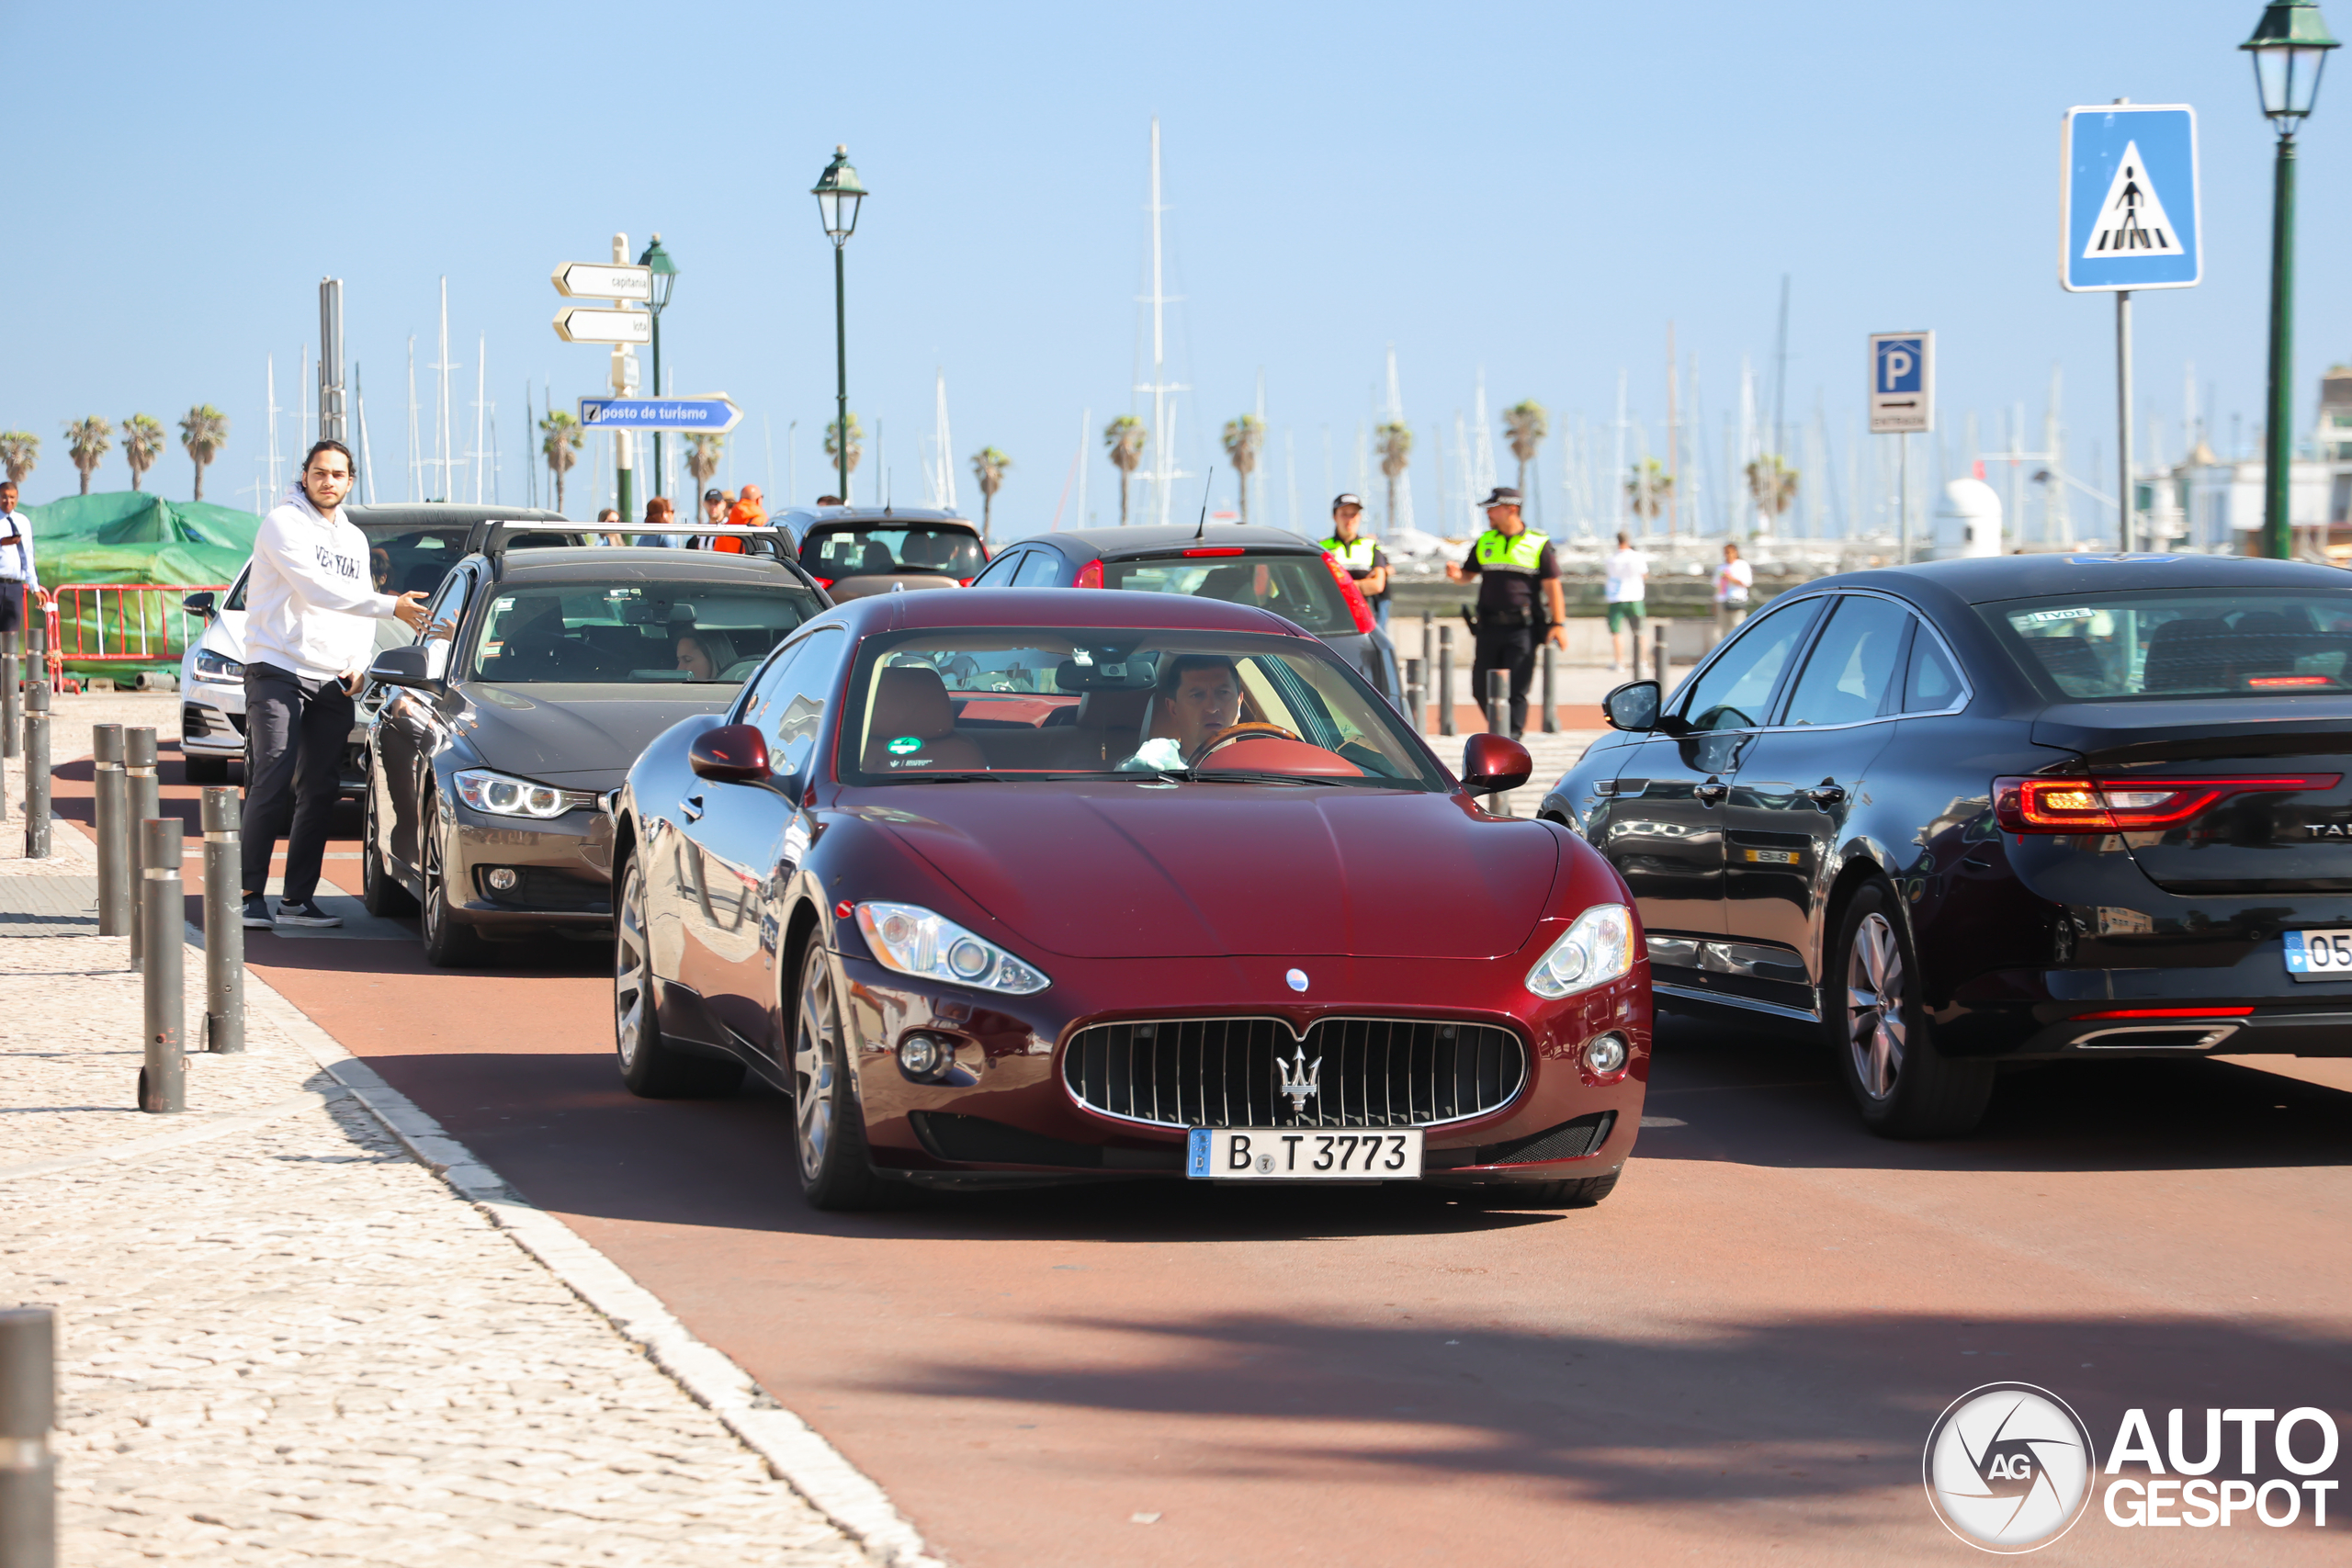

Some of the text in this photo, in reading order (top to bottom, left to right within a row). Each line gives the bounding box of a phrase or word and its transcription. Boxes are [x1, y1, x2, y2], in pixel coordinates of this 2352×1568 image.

[612, 276, 647, 289] capitania
[1886, 350, 1913, 390] P
[602, 405, 638, 422] posto
[640, 405, 656, 420] de
[659, 403, 707, 420] turismo
[2039, 609, 2086, 620] TVDE
[2310, 935, 2352, 967] 05
[1229, 1135, 1252, 1169] B
[1282, 1135, 1304, 1170] T
[1313, 1135, 1406, 1170] 3773
